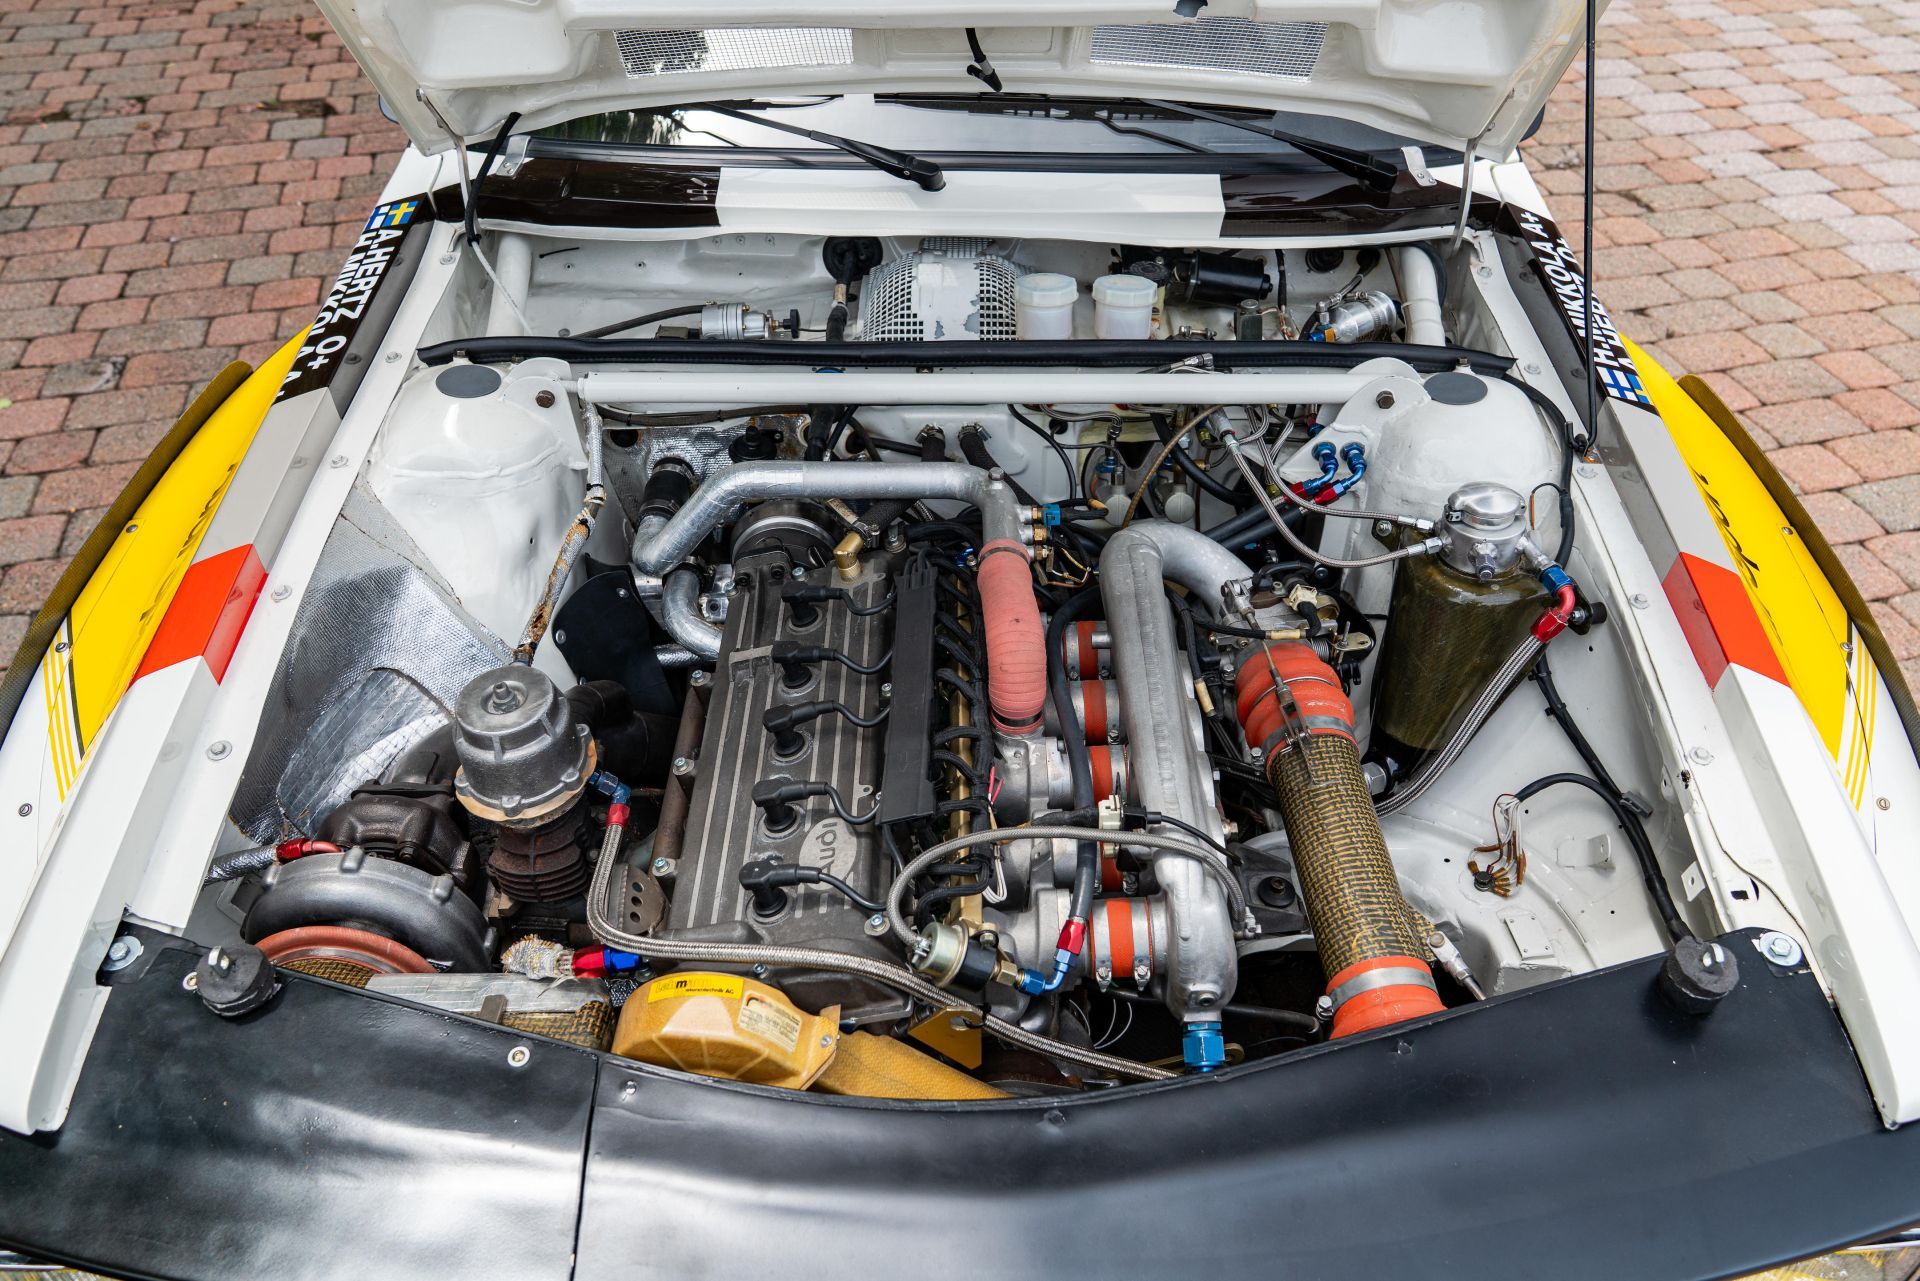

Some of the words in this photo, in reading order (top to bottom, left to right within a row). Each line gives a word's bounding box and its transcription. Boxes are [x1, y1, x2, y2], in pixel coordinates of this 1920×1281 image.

[1520, 211, 1549, 239] A+
[331, 229, 404, 323] A.HERTZ
[307, 335, 347, 370] O+
